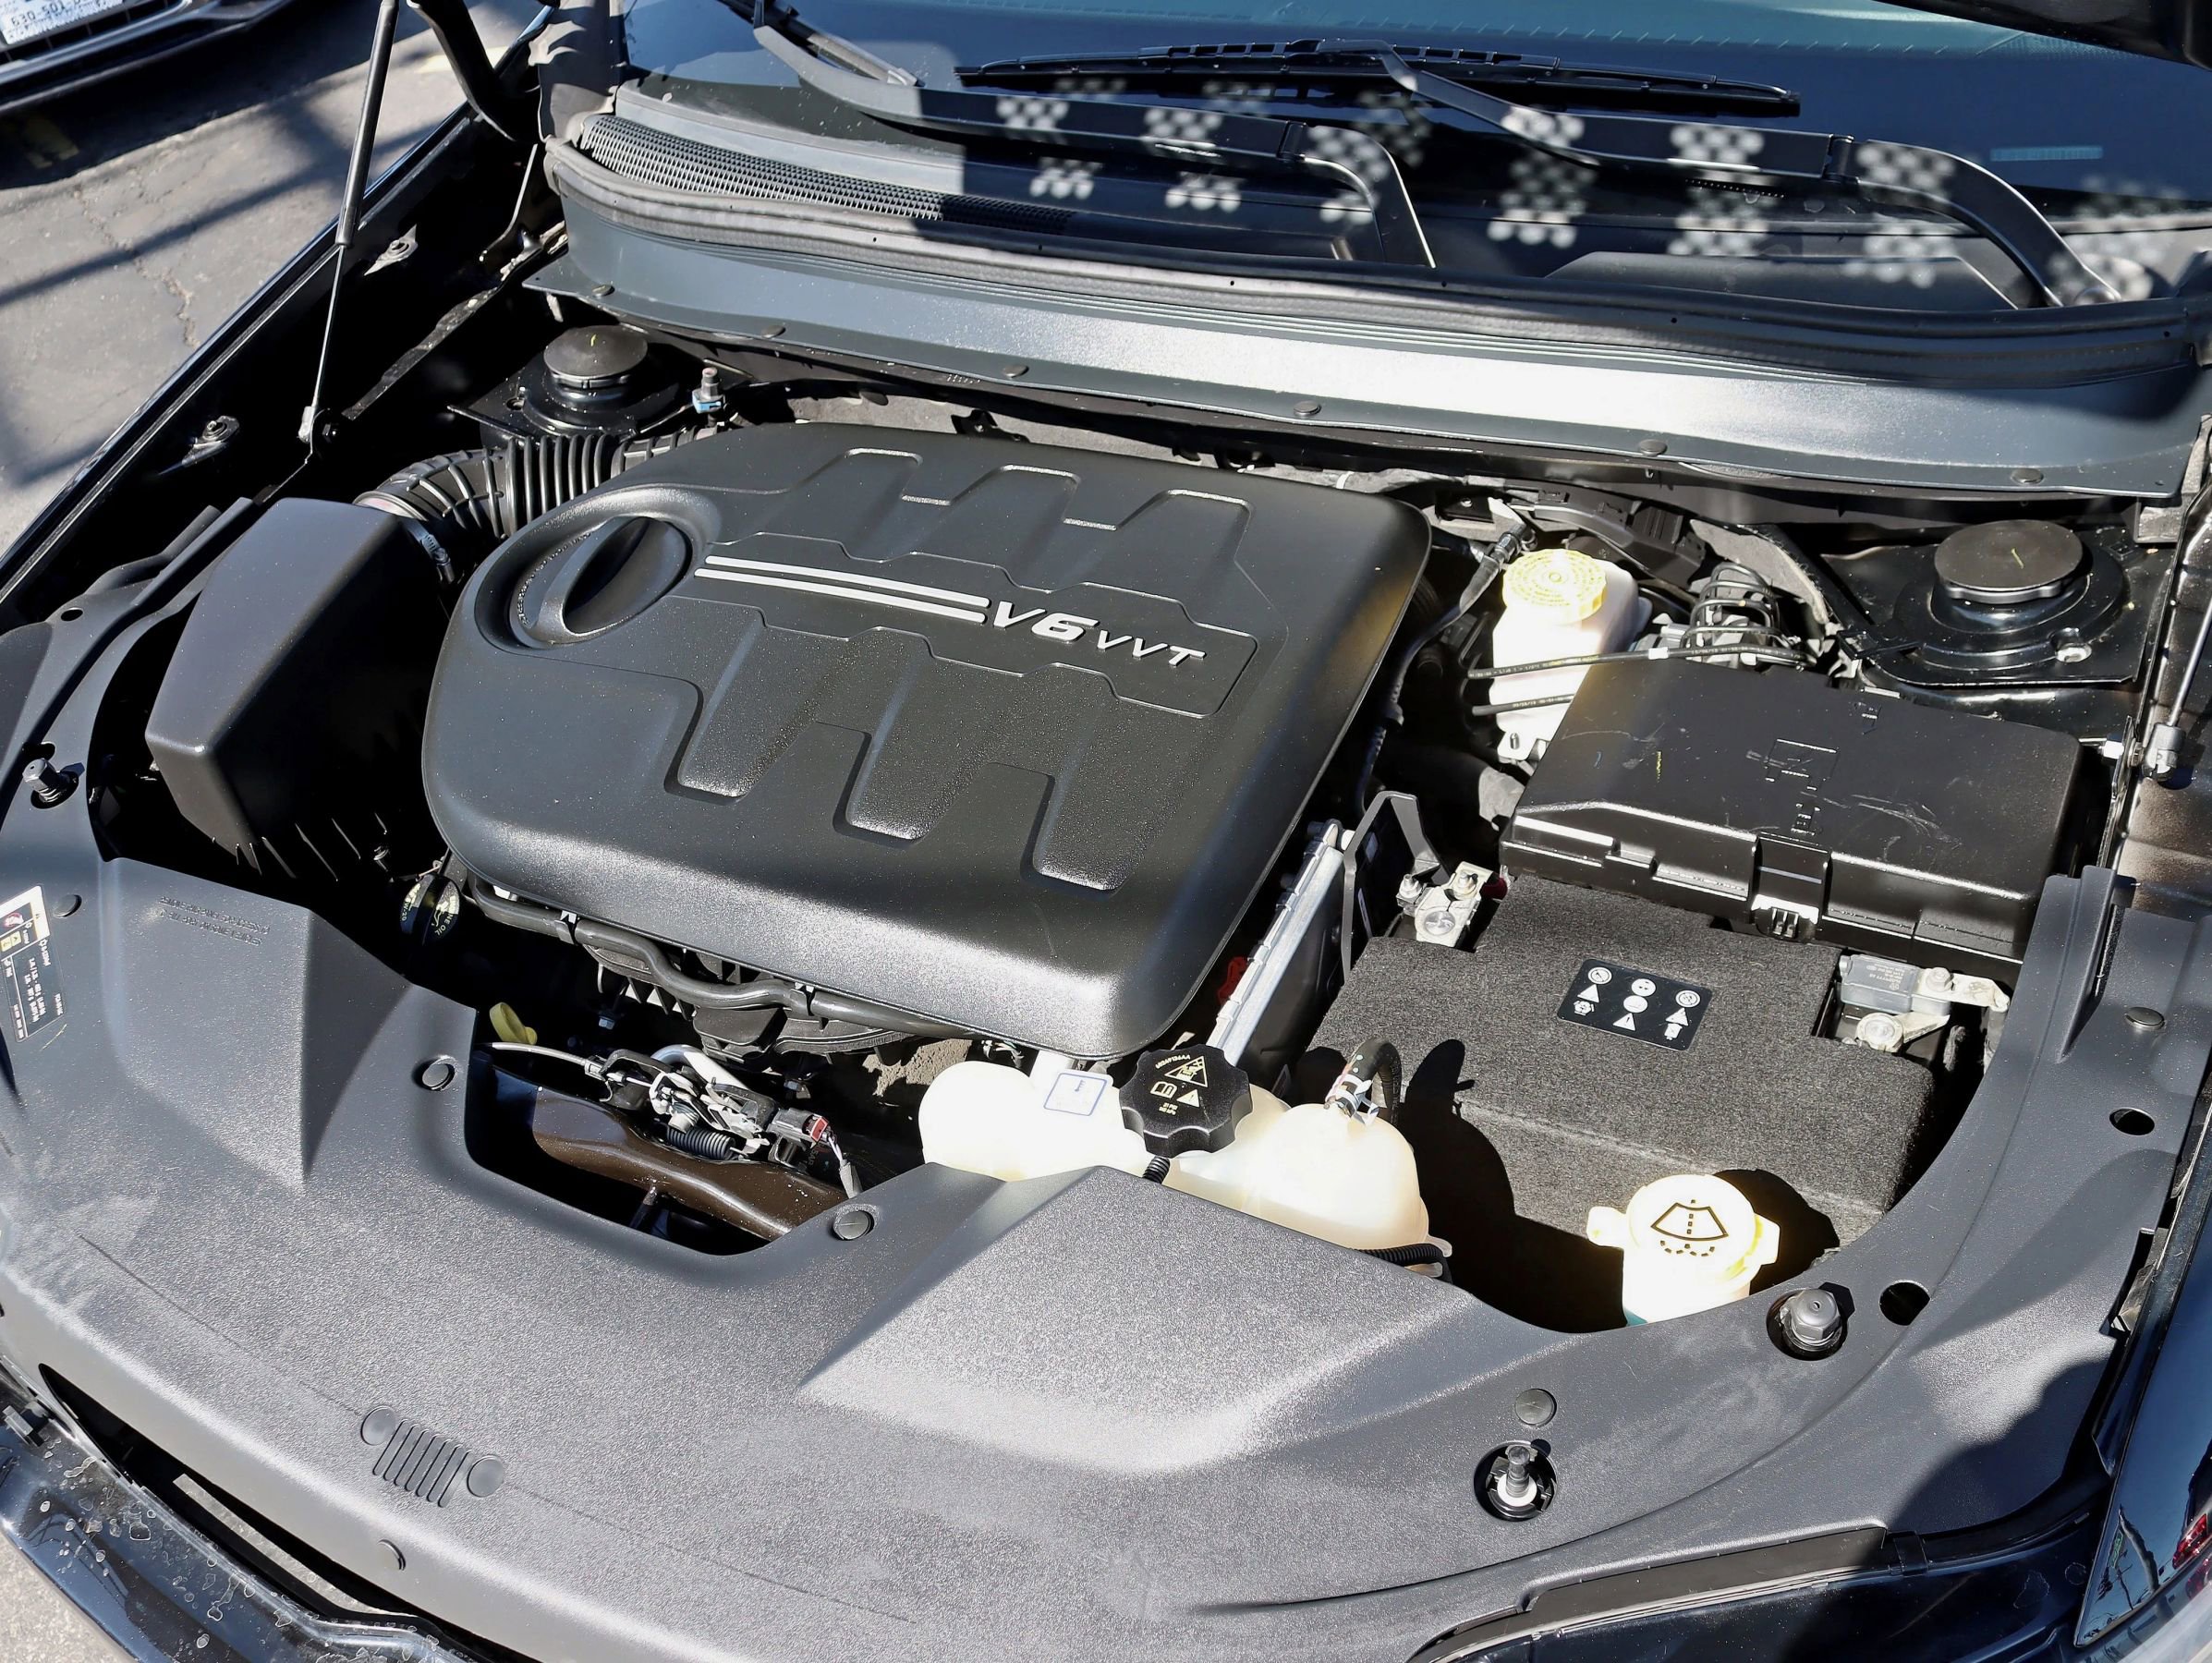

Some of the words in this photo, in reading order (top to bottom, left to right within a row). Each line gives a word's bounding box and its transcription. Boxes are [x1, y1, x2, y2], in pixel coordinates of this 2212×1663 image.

[993, 601, 1100, 642] V6
[1097, 630, 1207, 666] VVT
[434, 924, 446, 936] OIL
